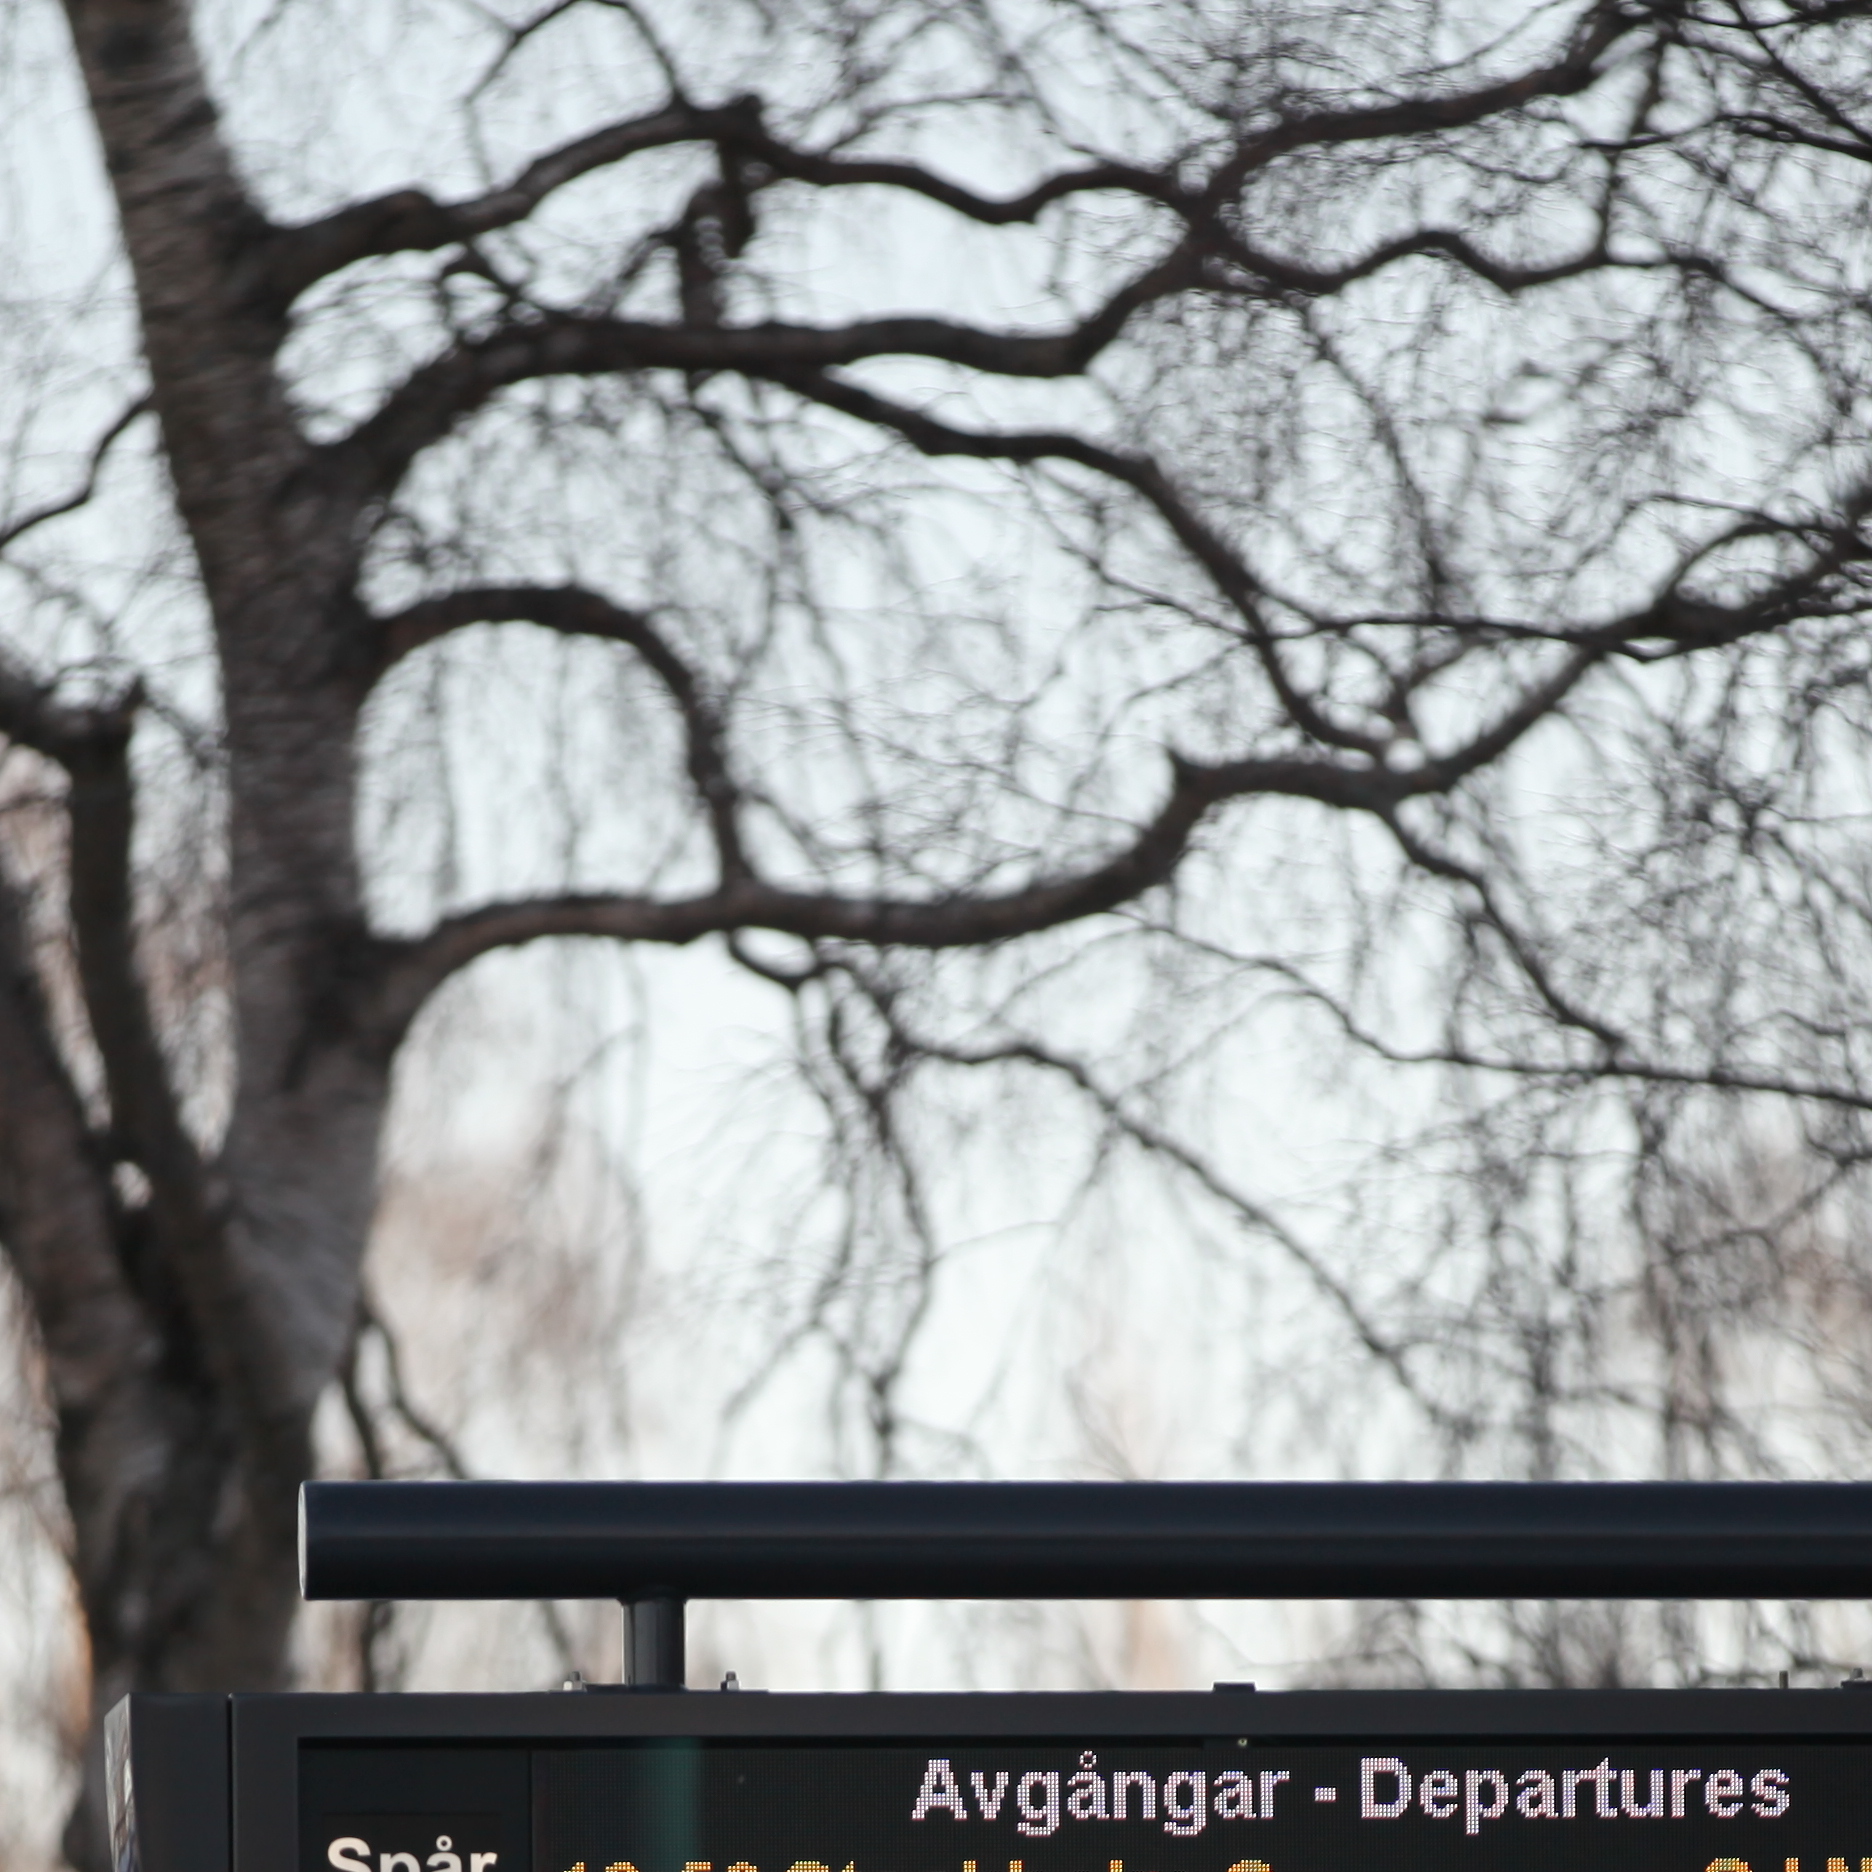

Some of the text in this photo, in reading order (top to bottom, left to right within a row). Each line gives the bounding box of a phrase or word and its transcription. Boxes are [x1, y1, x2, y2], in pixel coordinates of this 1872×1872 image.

[911, 1750, 1790, 1837] Avgångar - Departures
